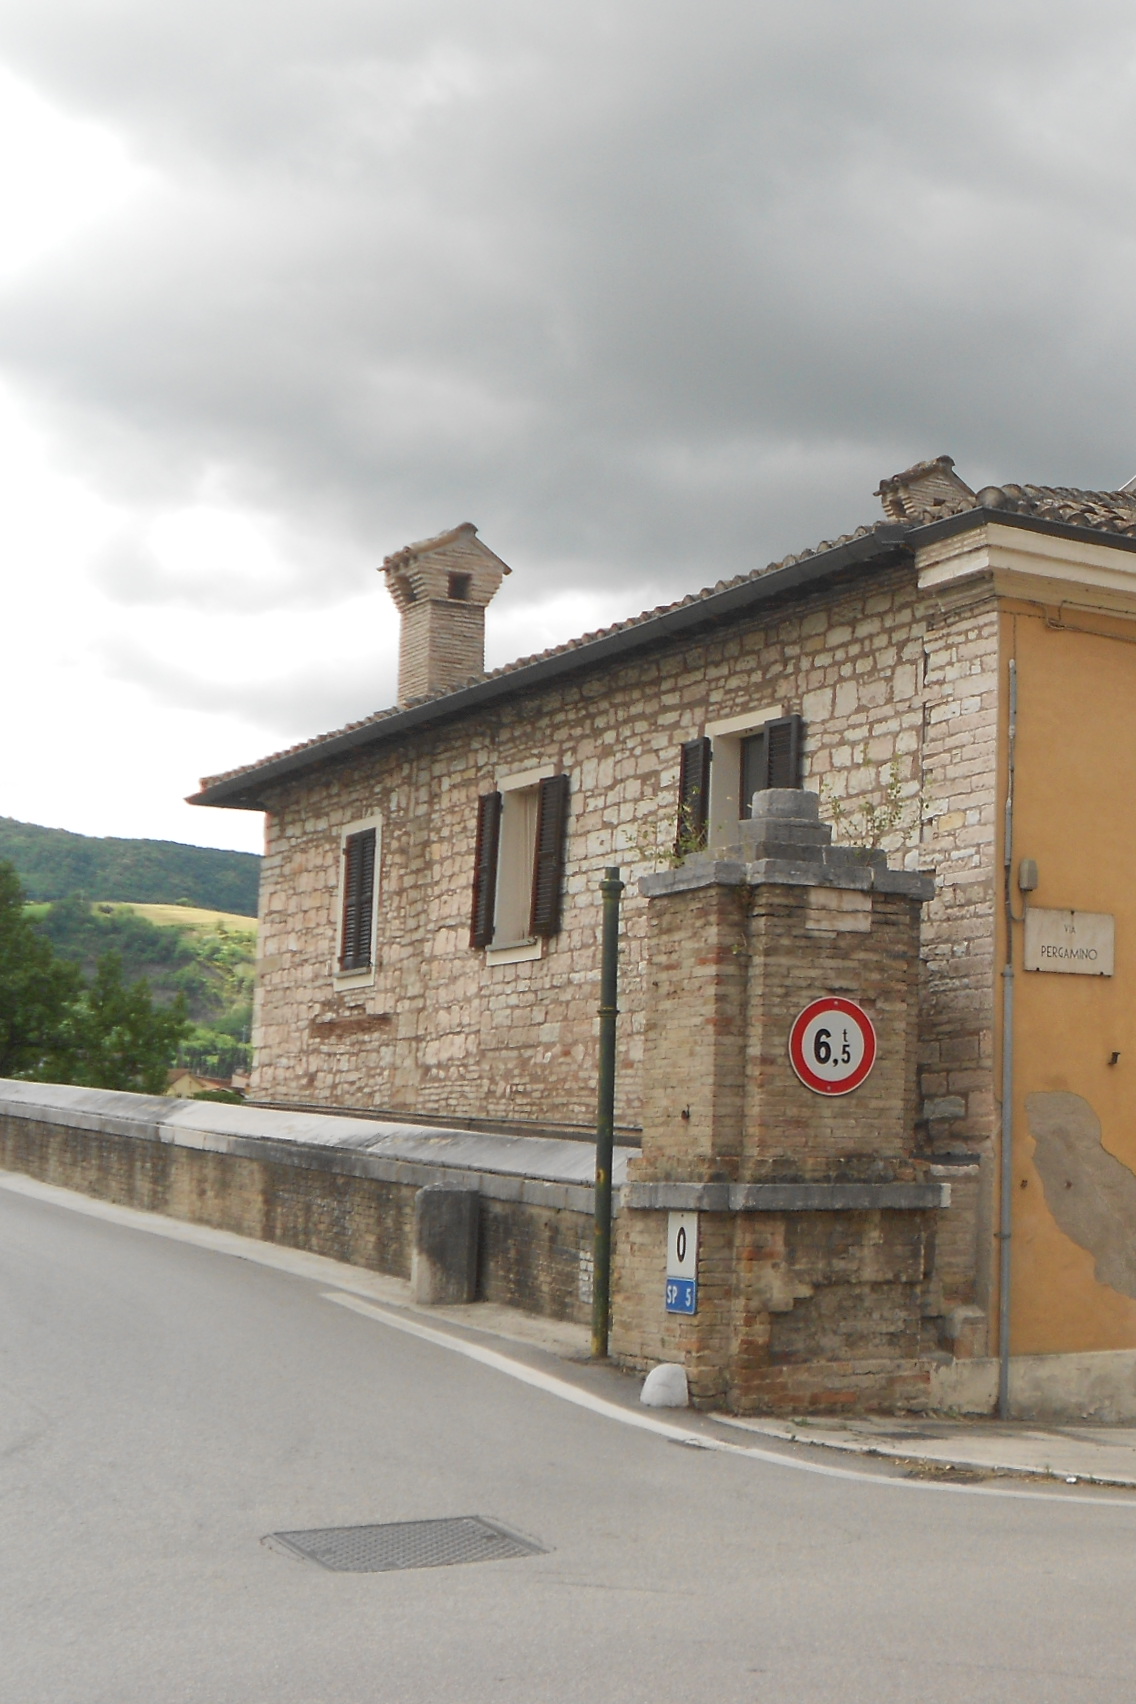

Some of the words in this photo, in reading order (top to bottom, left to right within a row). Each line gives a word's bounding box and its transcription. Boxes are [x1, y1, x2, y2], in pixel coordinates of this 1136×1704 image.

[1064, 924, 1076, 934] VIA
[1041, 945, 1098, 961] PERGAMINO
[676, 1226, 687, 1263] 0
[667, 1285, 678, 1305] SP
[685, 1288, 692, 1307] 5
